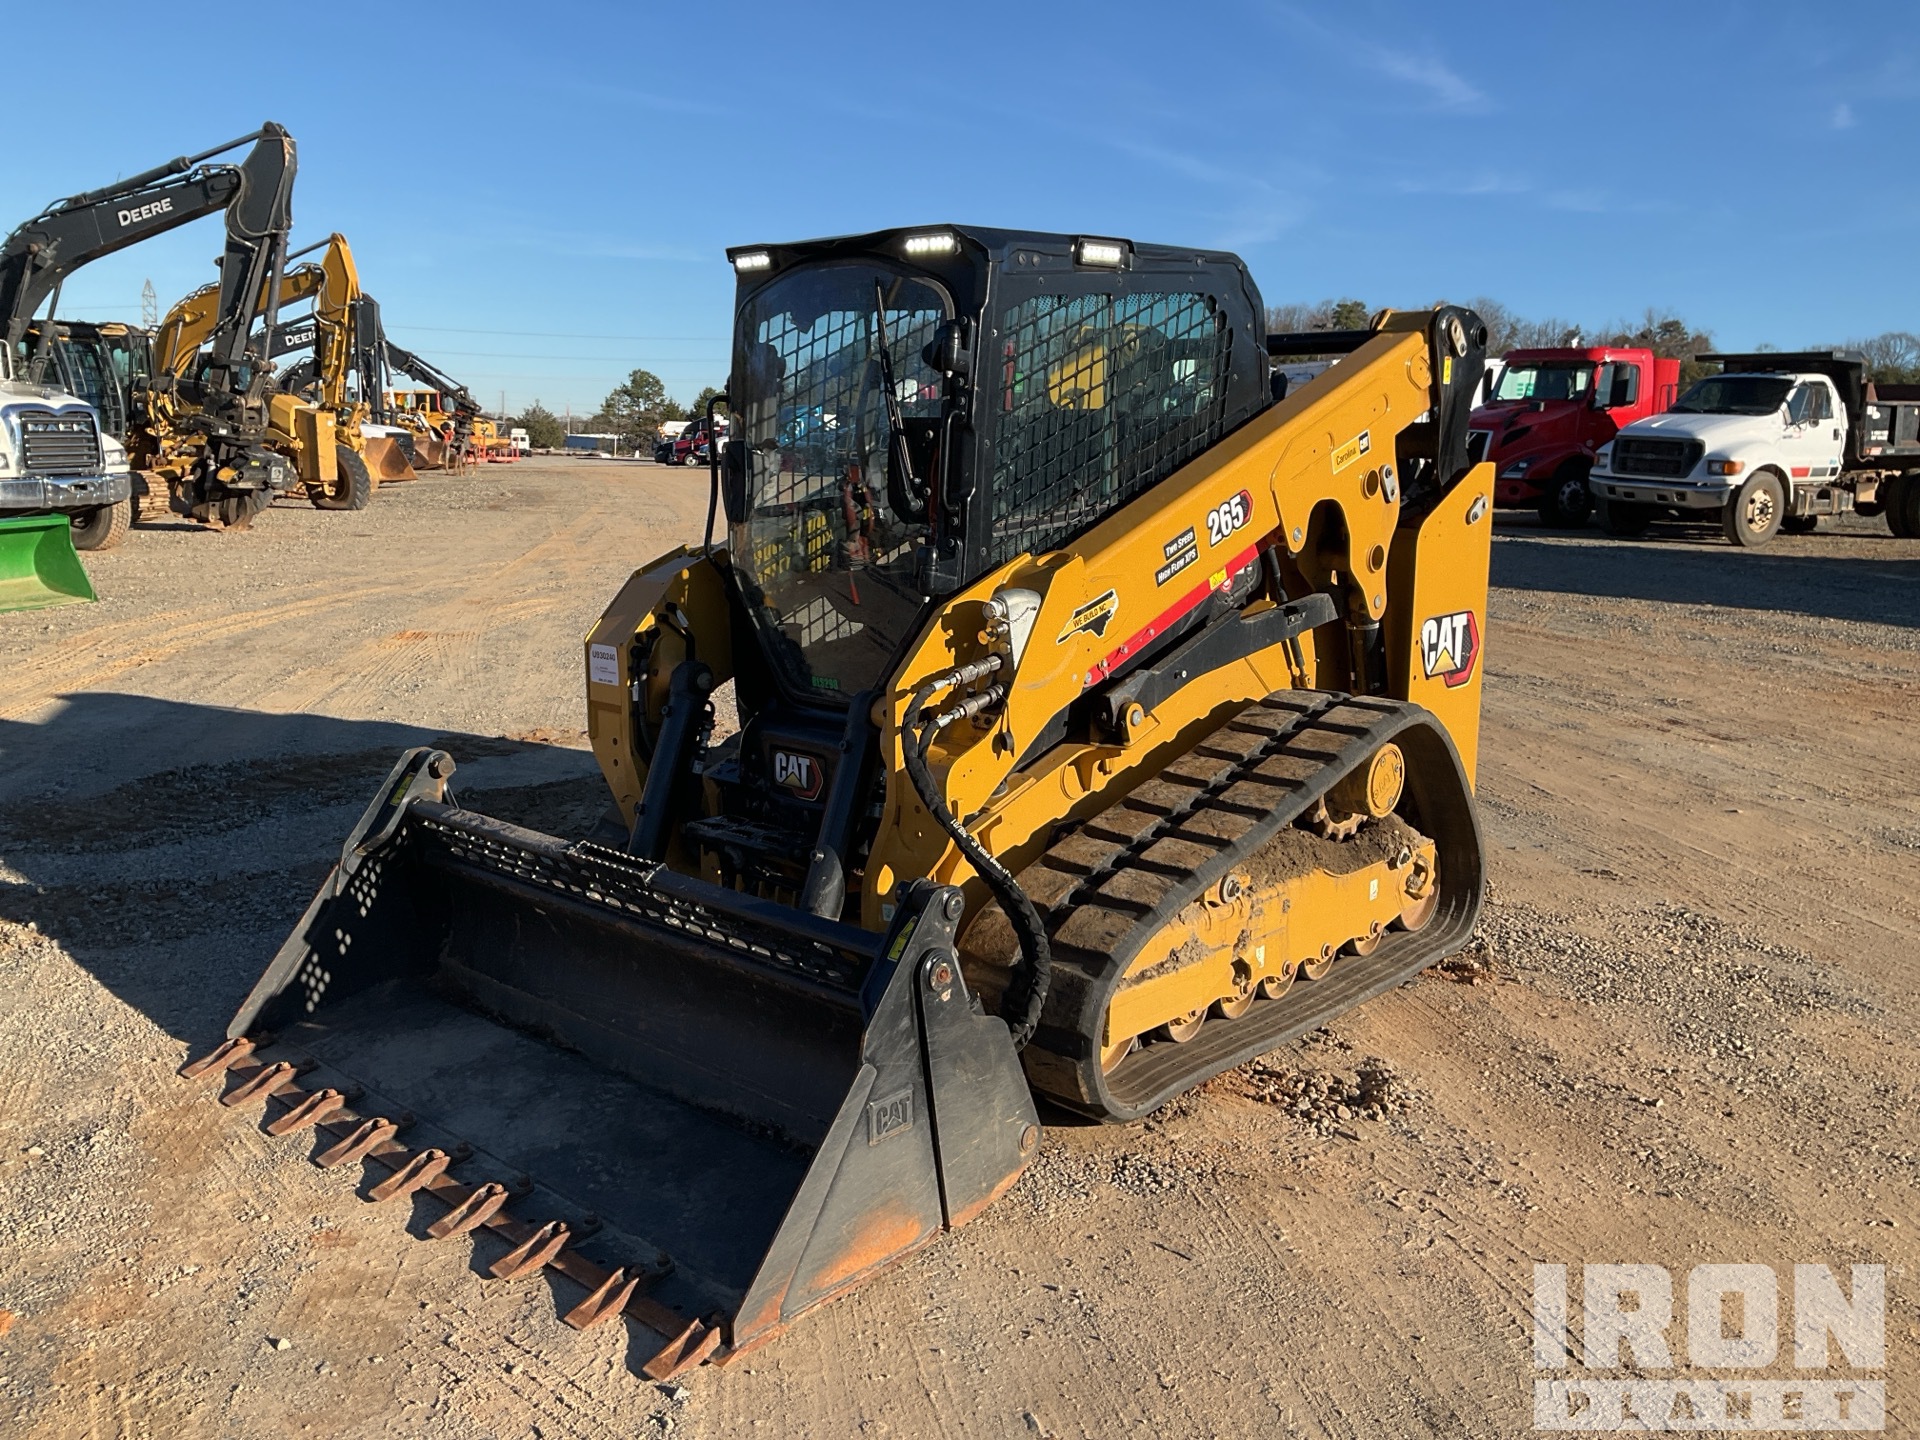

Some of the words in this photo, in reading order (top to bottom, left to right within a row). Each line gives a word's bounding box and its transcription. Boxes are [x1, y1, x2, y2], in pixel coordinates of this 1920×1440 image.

[117, 197, 173, 227] DEERE
[27, 422, 90, 432] MACK
[1336, 447, 1357, 466] Carolina
[1207, 494, 1244, 546] 265
[1073, 617, 1083, 628] WE
[1083, 608, 1098, 622] BUILD
[1099, 602, 1107, 613] NC
[1422, 612, 1467, 676] CAT
[776, 752, 810, 789] CAT
[876, 1095, 910, 1136] CAT
